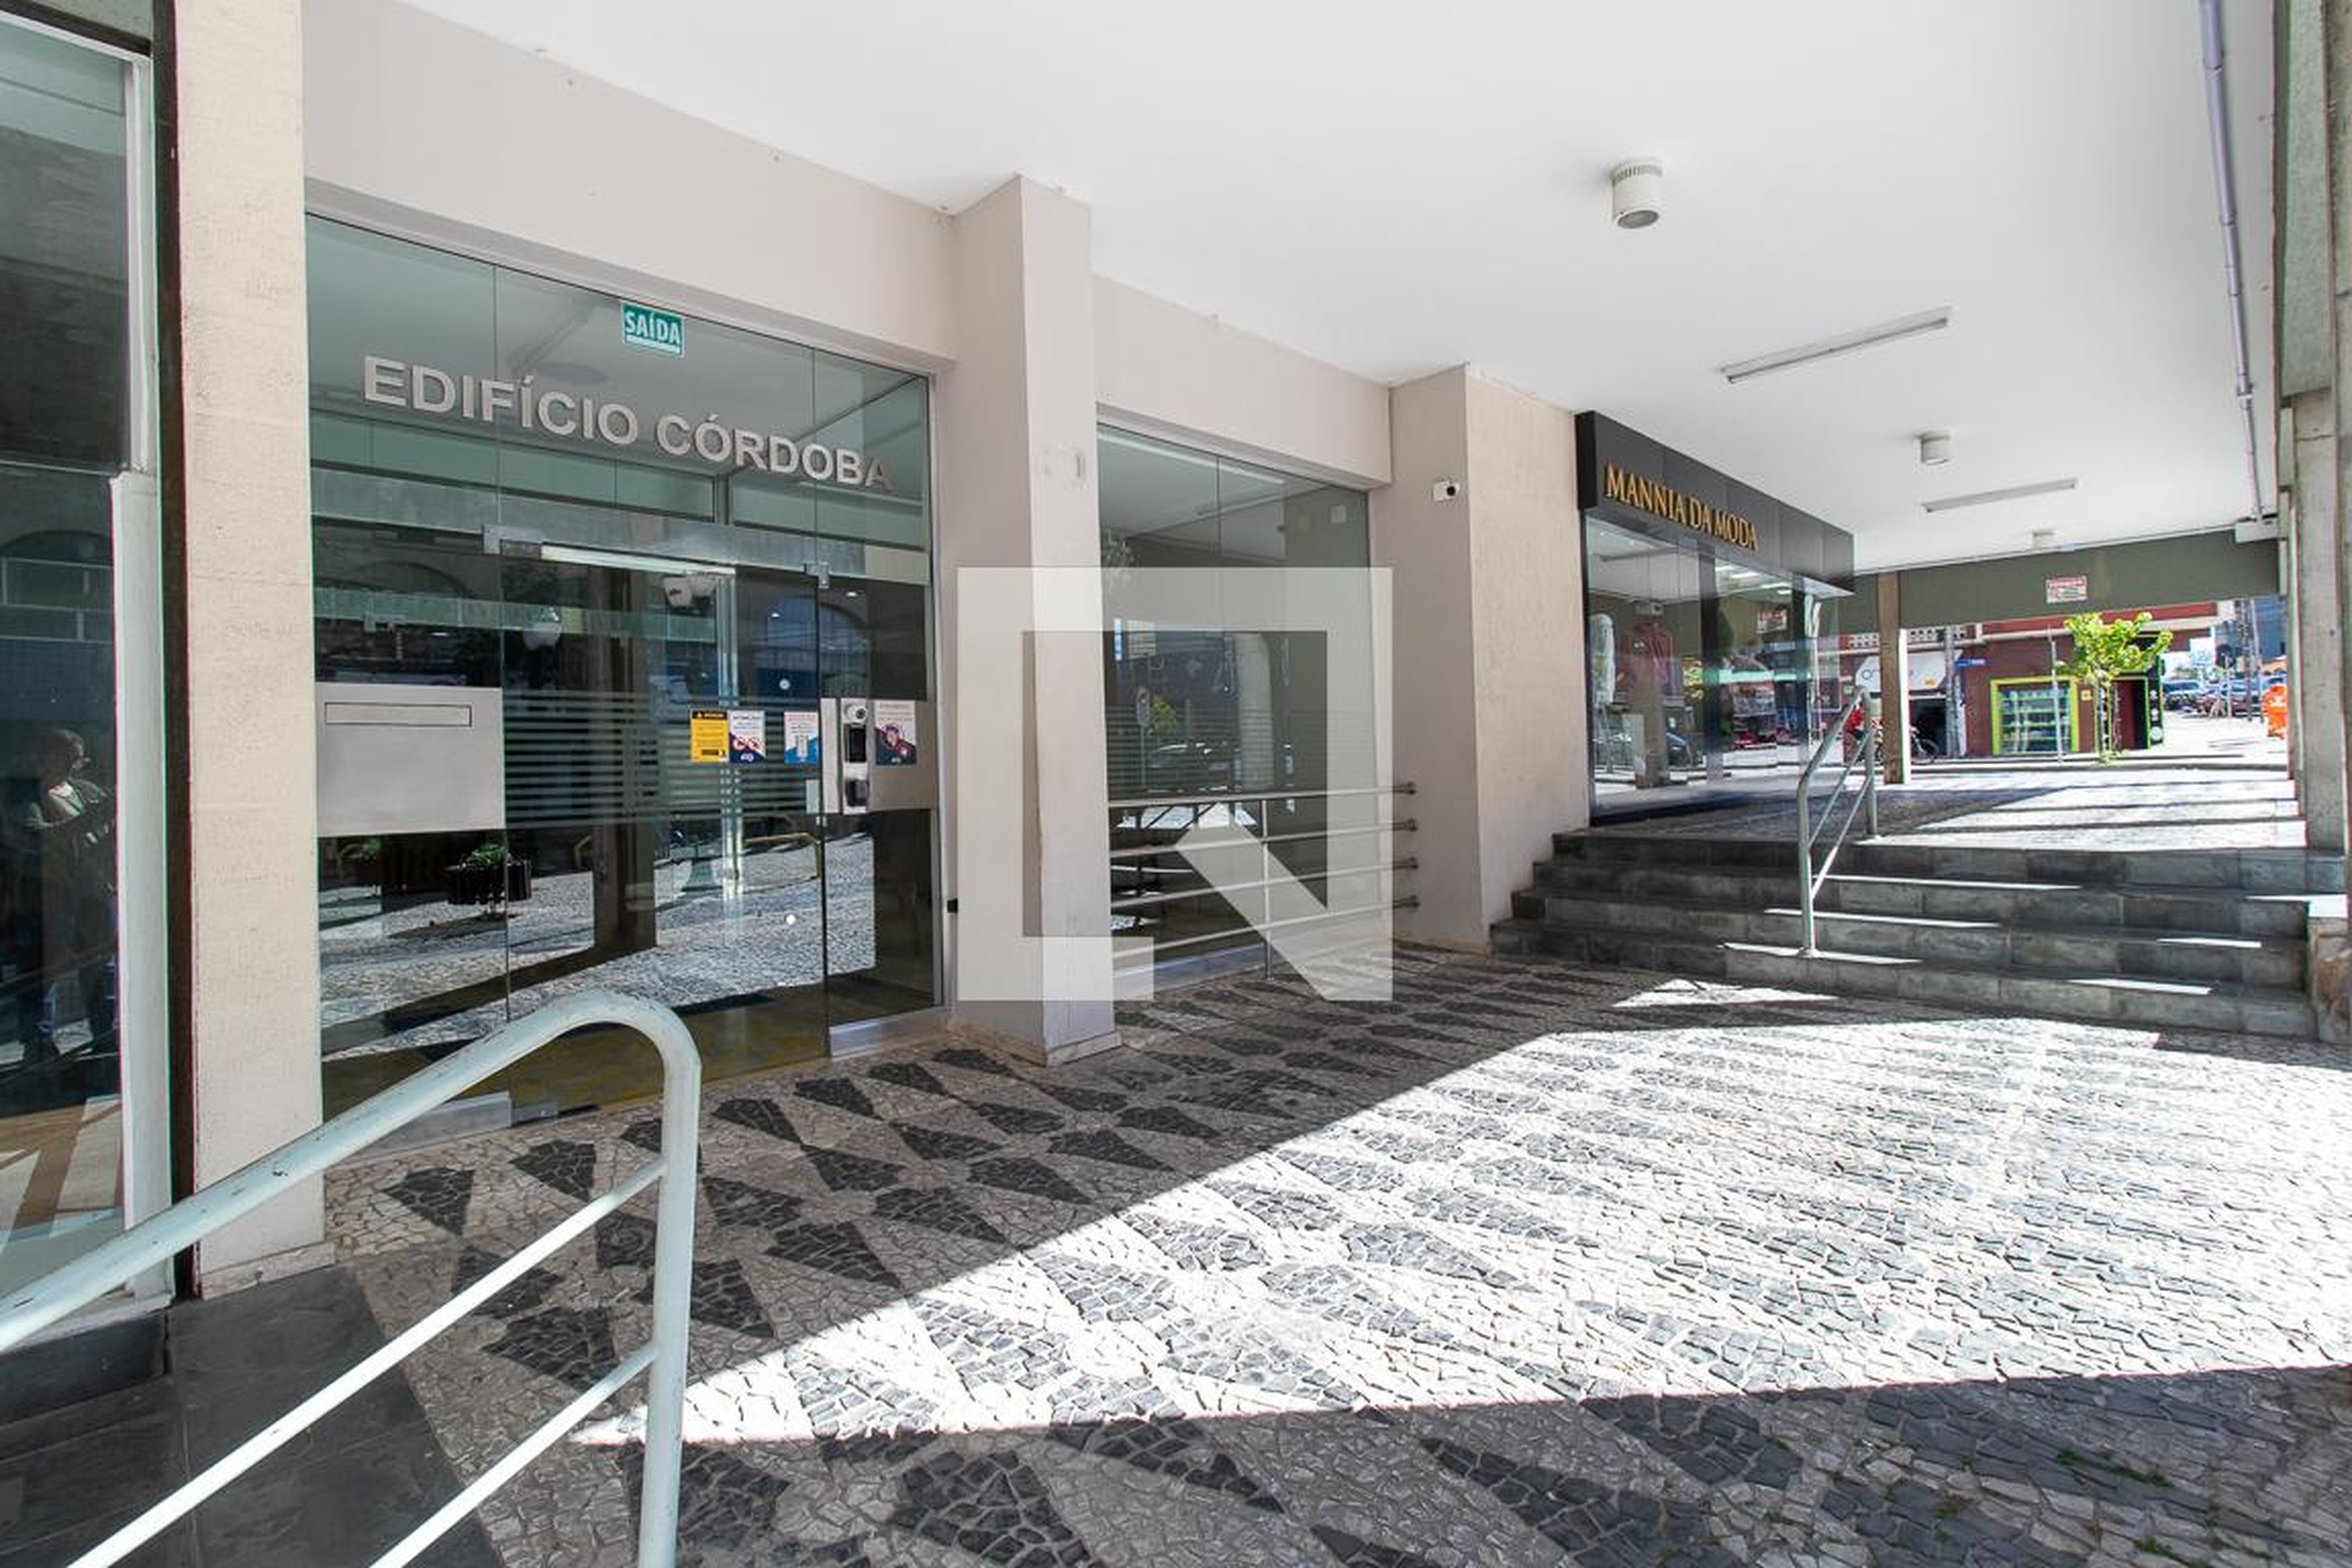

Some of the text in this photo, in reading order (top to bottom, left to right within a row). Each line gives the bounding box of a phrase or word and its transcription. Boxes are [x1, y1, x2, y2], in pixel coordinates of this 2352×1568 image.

[625, 311, 680, 345] SAÍDA
[364, 355, 892, 490] EDIFÍCIO CÓRDOBA
[1605, 462, 1759, 552] MANNIA DA MODA
